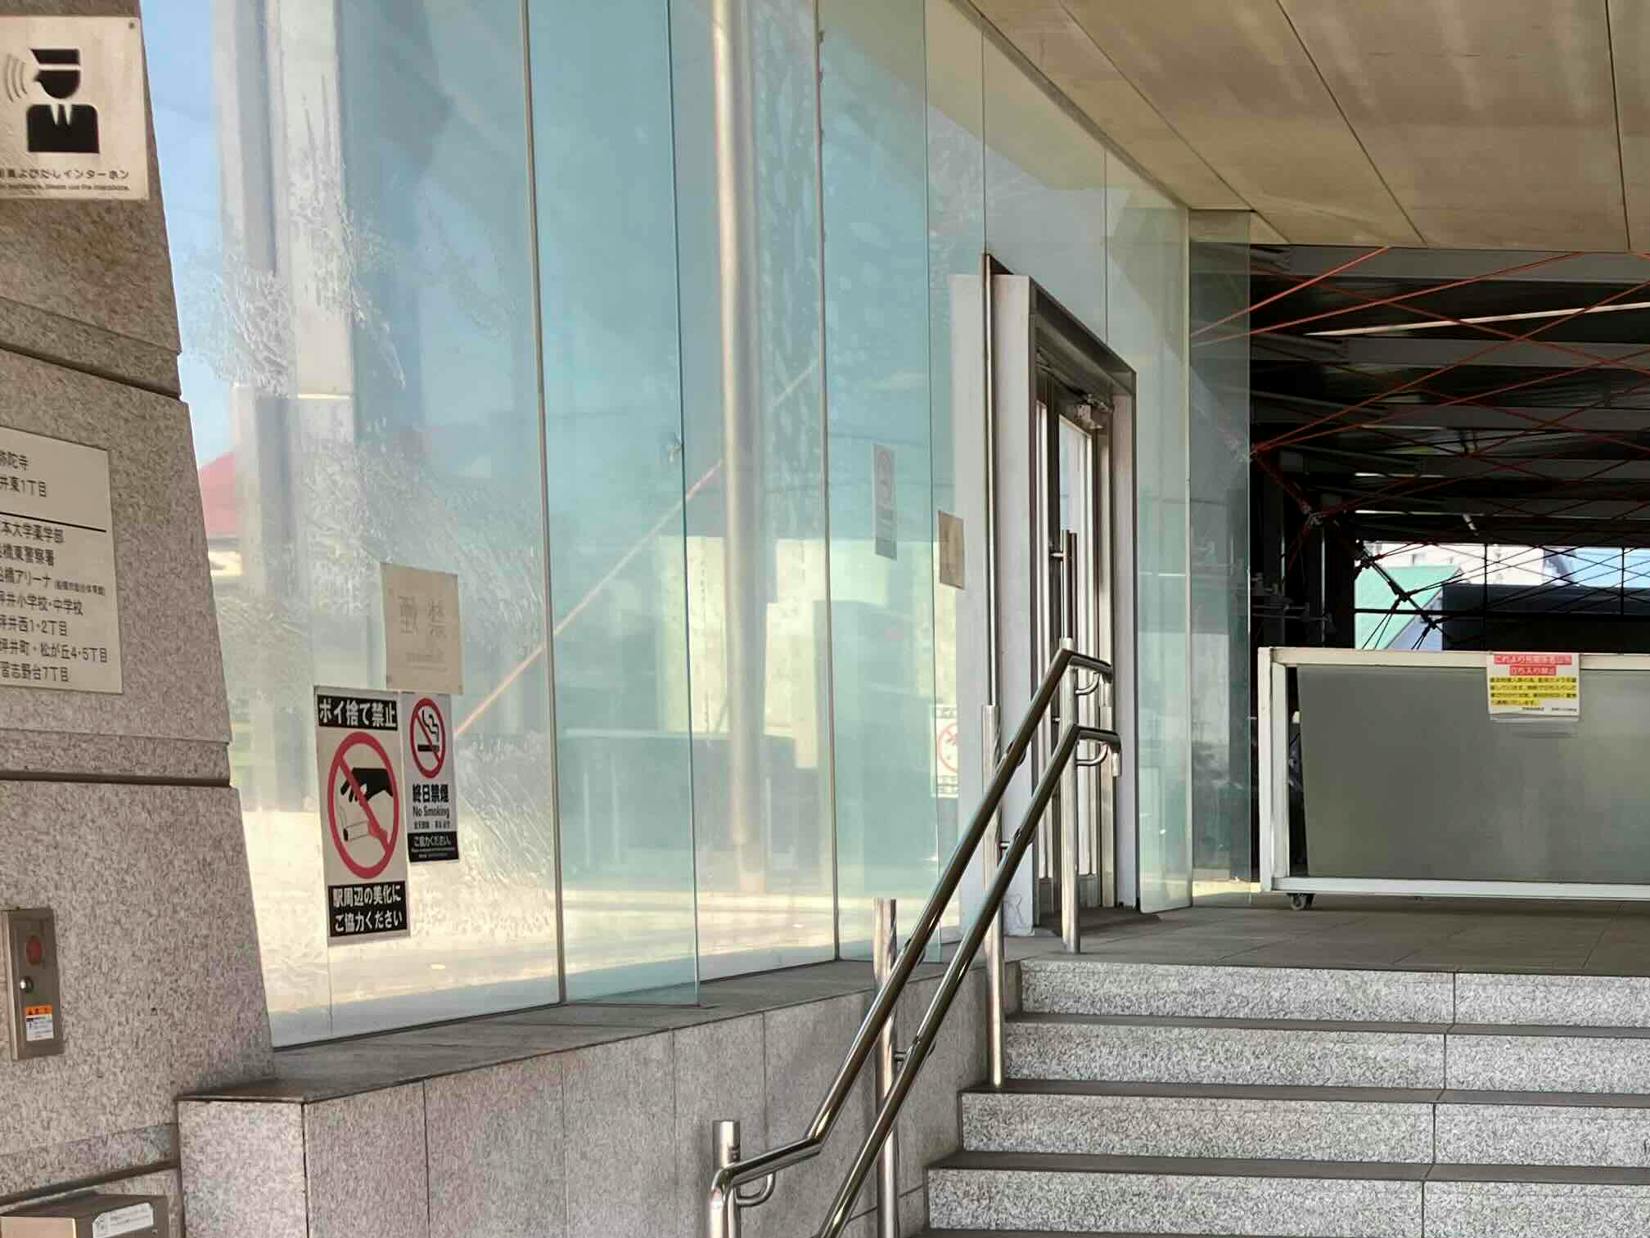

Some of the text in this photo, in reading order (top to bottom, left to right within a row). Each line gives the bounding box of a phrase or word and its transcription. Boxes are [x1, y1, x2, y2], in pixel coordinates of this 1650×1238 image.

[319, 698, 397, 727] ポイ捨て禁止
[412, 805, 450, 819] No Smoking
[333, 885, 402, 908] 駅周辺の美化に
[335, 909, 403, 933] ご協力ください
